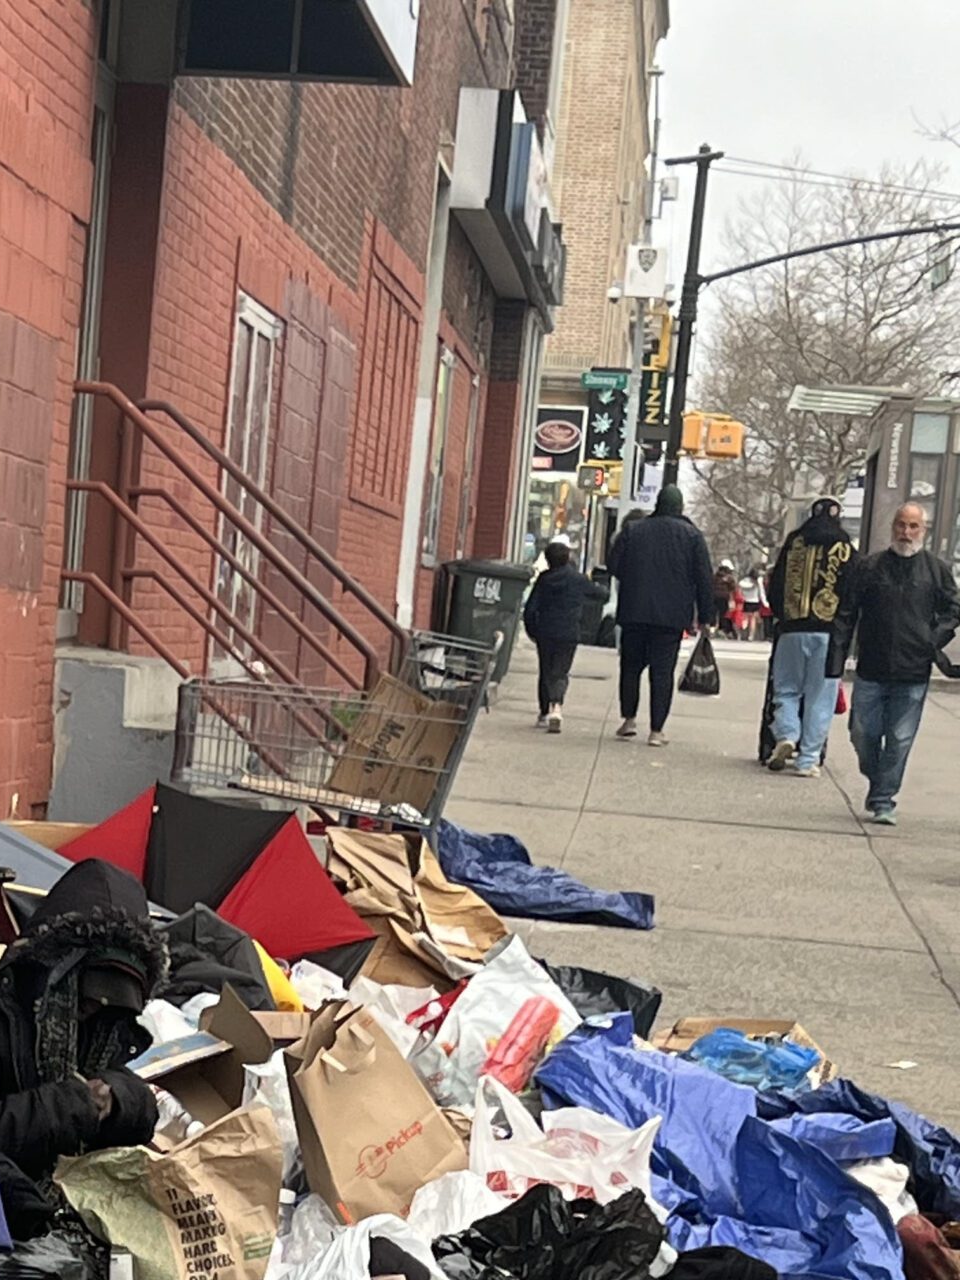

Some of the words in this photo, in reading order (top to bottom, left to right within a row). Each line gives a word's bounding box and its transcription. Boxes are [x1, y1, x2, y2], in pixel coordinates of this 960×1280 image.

[887, 422, 904, 489] Newsstand
[386, 1121, 423, 1154] Pickup
[180, 1222, 226, 1244] MAKIG
